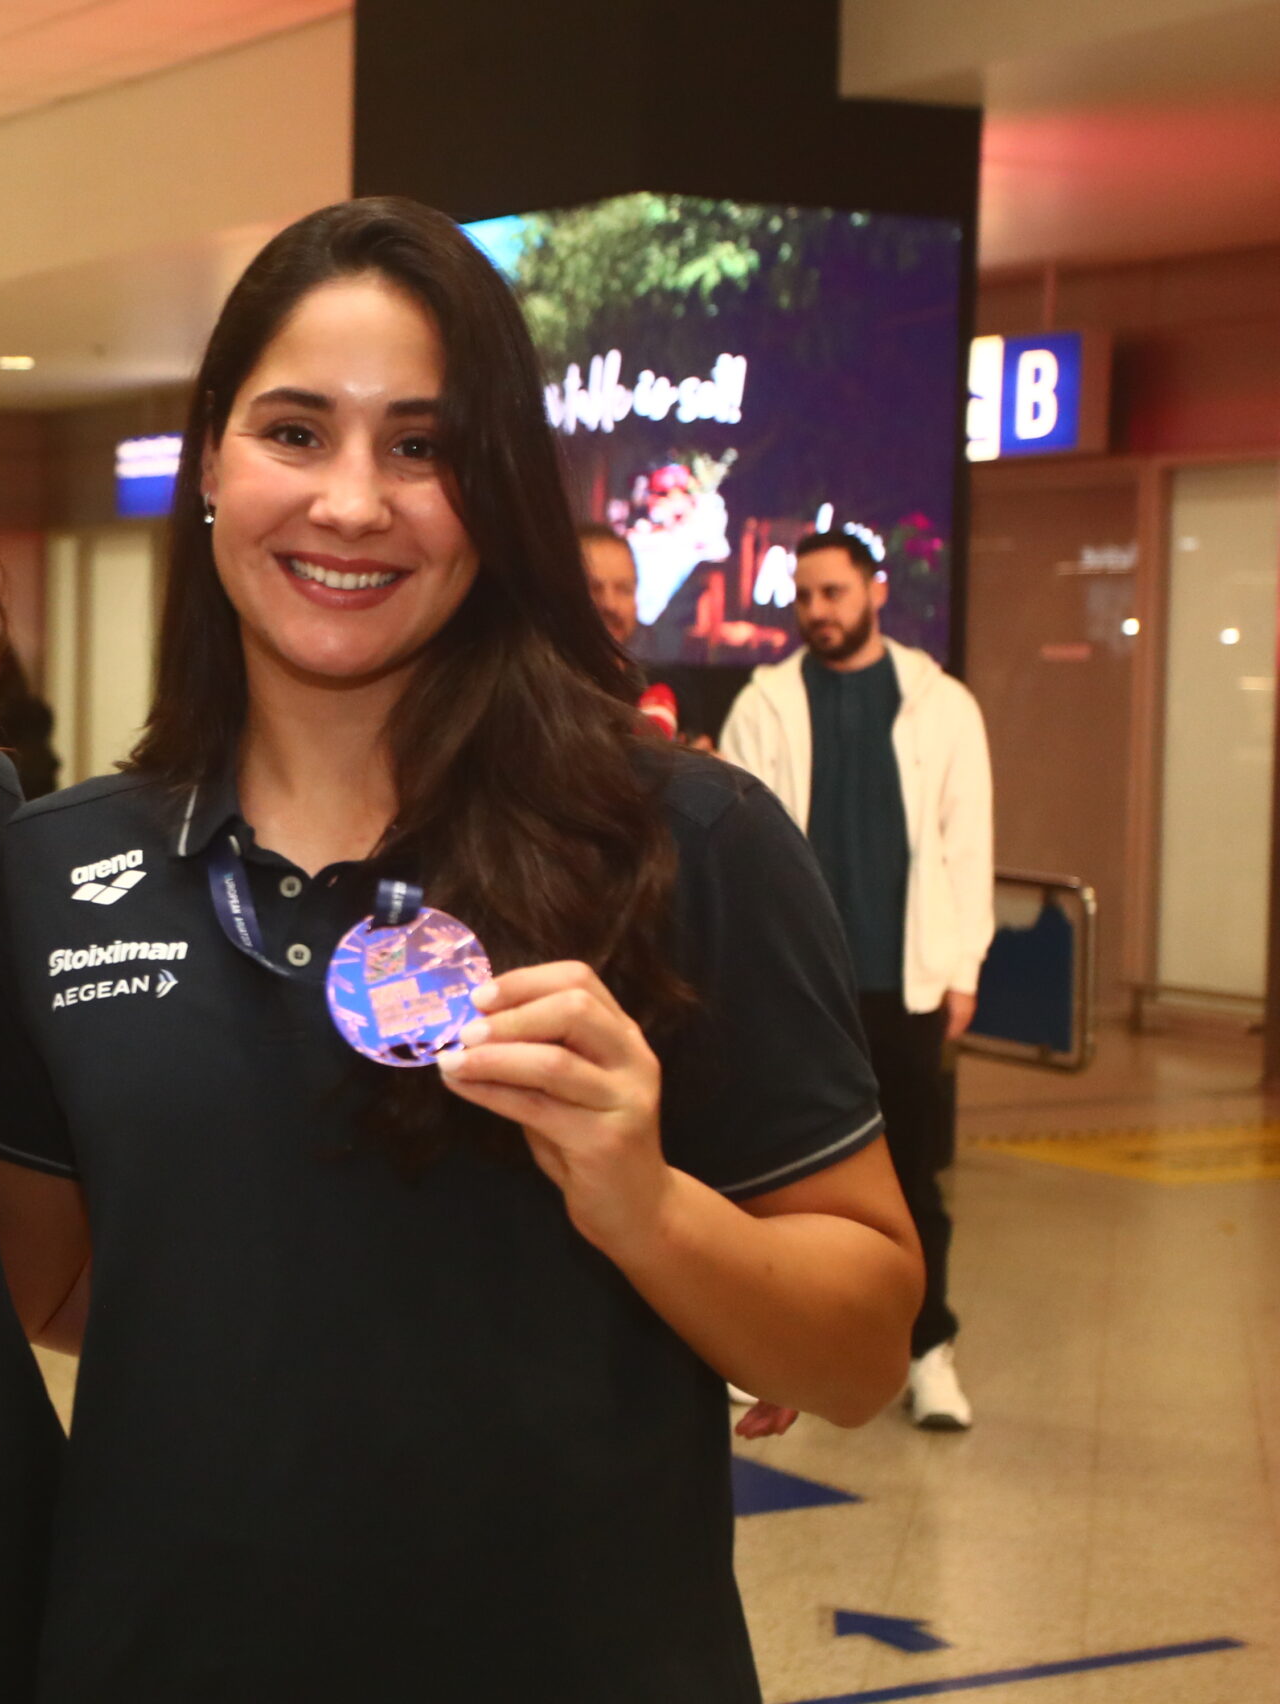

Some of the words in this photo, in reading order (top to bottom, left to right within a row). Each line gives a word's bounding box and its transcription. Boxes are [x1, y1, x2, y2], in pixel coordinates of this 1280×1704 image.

[1016, 348, 1059, 440] B
[71, 849, 144, 885] arena
[48, 940, 188, 977] Stoiximan
[51, 975, 150, 1012] AEGEAN
